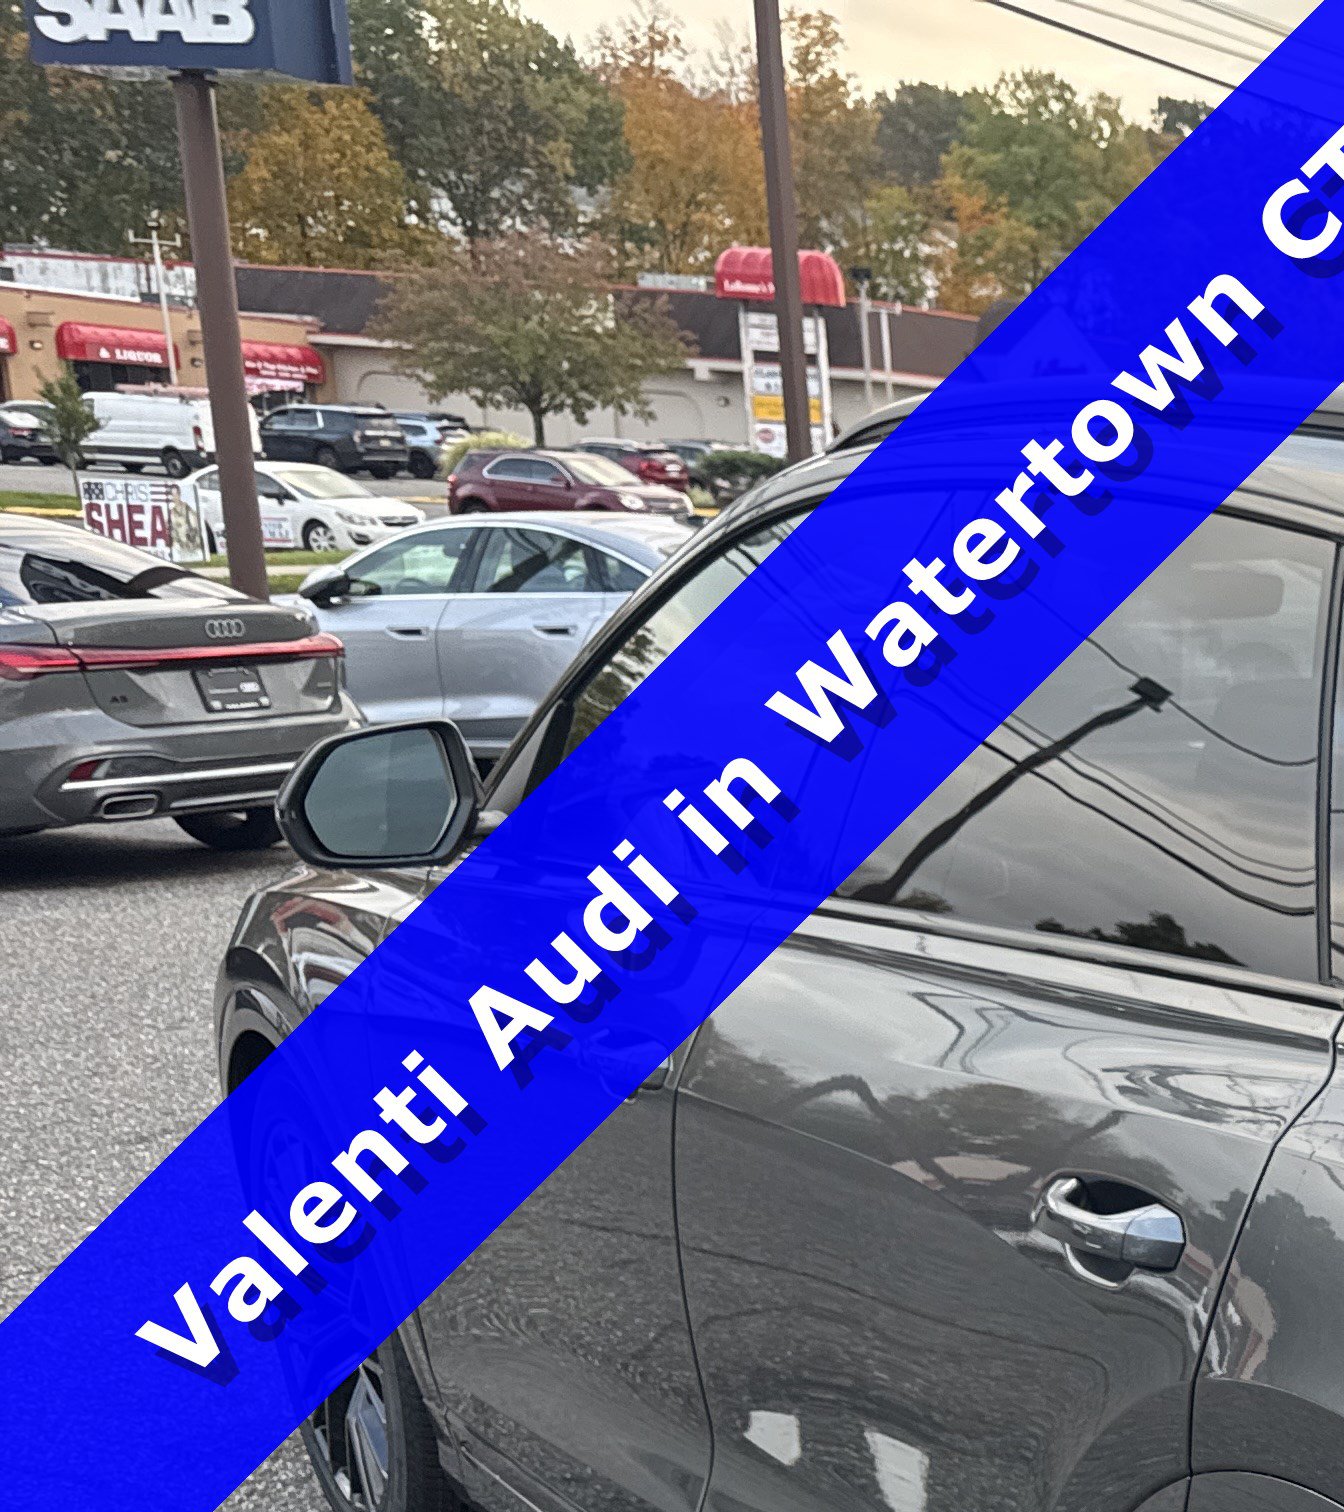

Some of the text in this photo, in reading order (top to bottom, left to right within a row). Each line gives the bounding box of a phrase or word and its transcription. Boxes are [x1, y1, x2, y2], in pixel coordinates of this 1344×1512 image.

[115, 347, 163, 364] LIQUOR
[104, 482, 151, 501] CHRIS
[85, 502, 174, 547] SHEA
